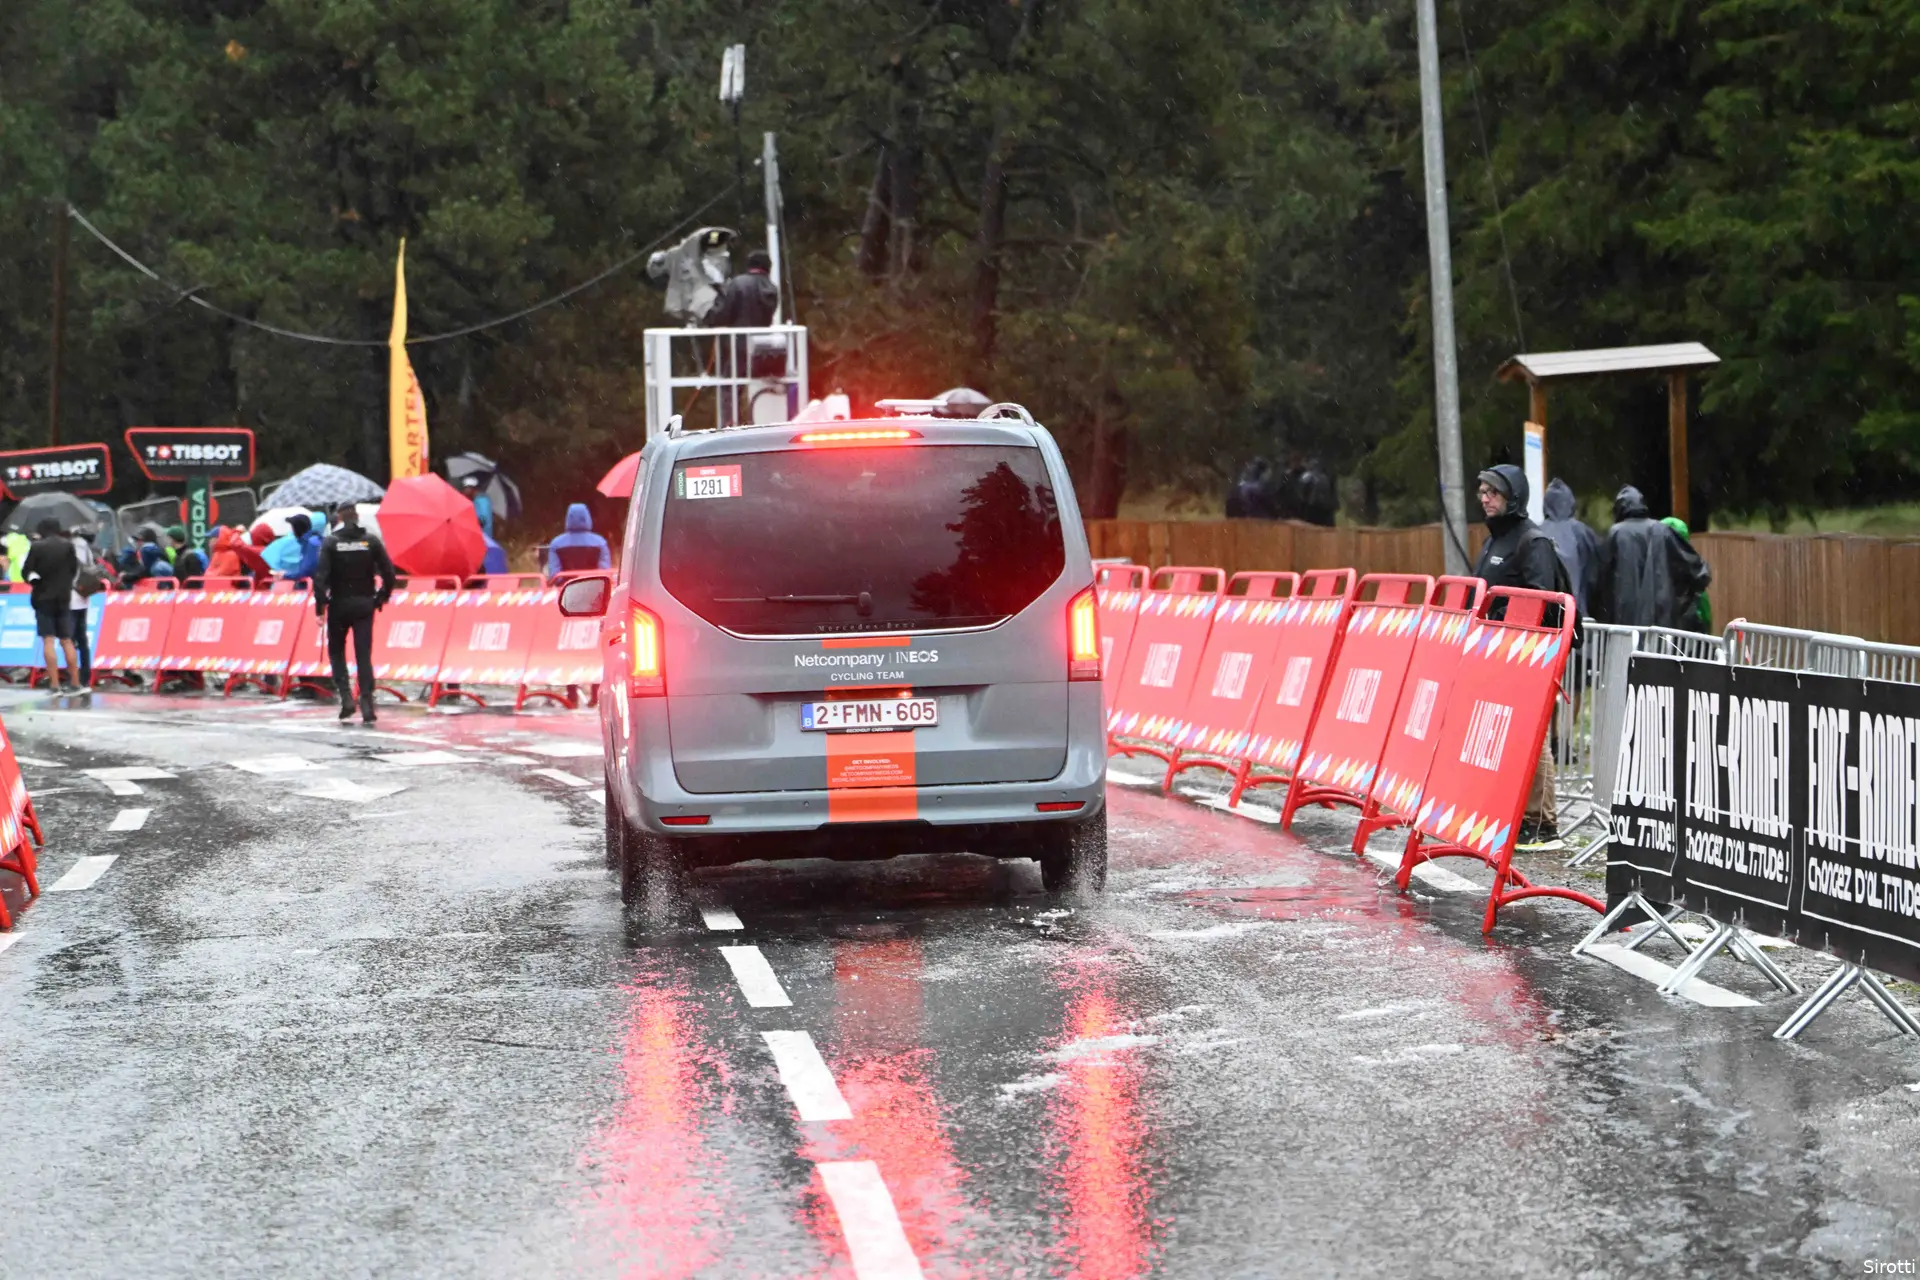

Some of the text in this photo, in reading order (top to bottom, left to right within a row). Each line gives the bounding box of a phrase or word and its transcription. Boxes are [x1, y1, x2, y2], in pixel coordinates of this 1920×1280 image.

[172, 444, 242, 460] TISSOT
[32, 459, 99, 477] TISSOT
[693, 479, 723, 496] 1291
[192, 487, 206, 550] KODA
[817, 622, 916, 632] Mercedes-Benz
[794, 649, 939, 668] Netcompany INEOS
[830, 671, 904, 681] CYCLING TEAM
[804, 717, 813, 727] B
[1808, 704, 1920, 870] FONT-ROME
